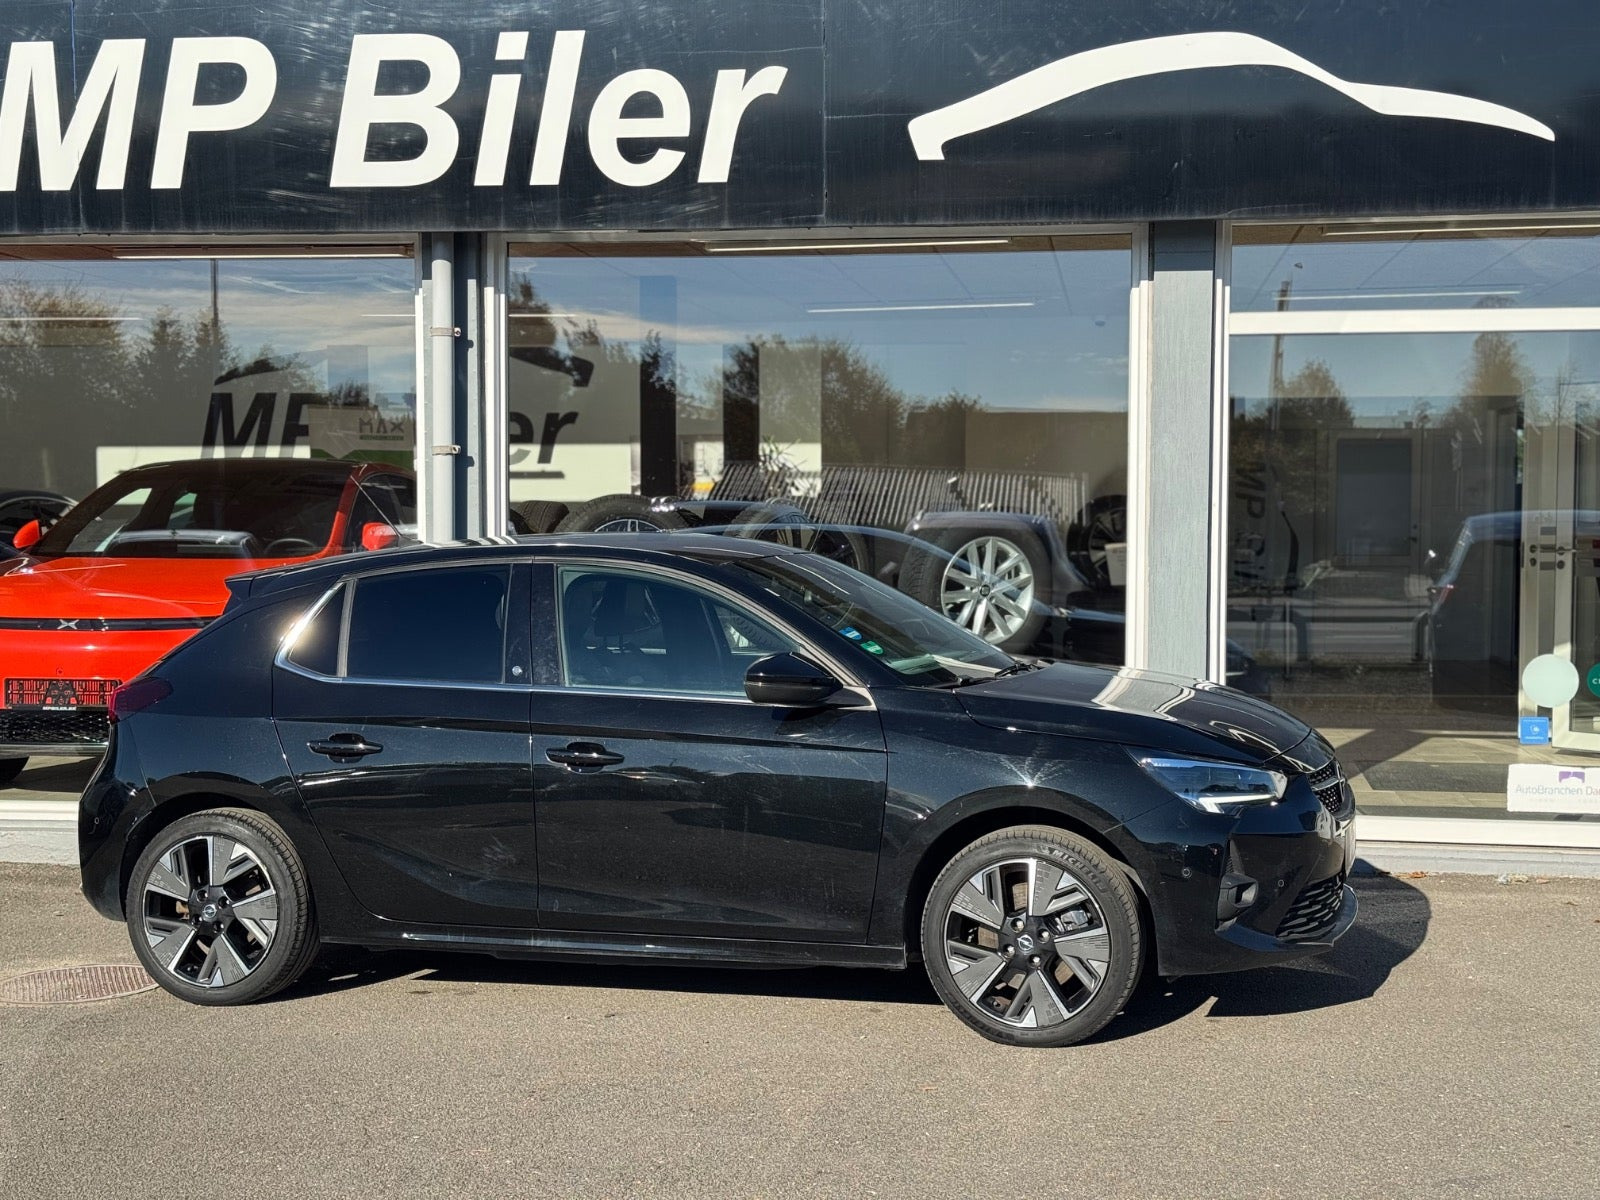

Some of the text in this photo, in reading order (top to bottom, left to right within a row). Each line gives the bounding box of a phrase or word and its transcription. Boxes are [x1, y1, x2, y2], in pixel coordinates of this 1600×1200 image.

[0, 30, 788, 191] MP Biler
[1515, 784, 1583, 796] AutoBranchen
